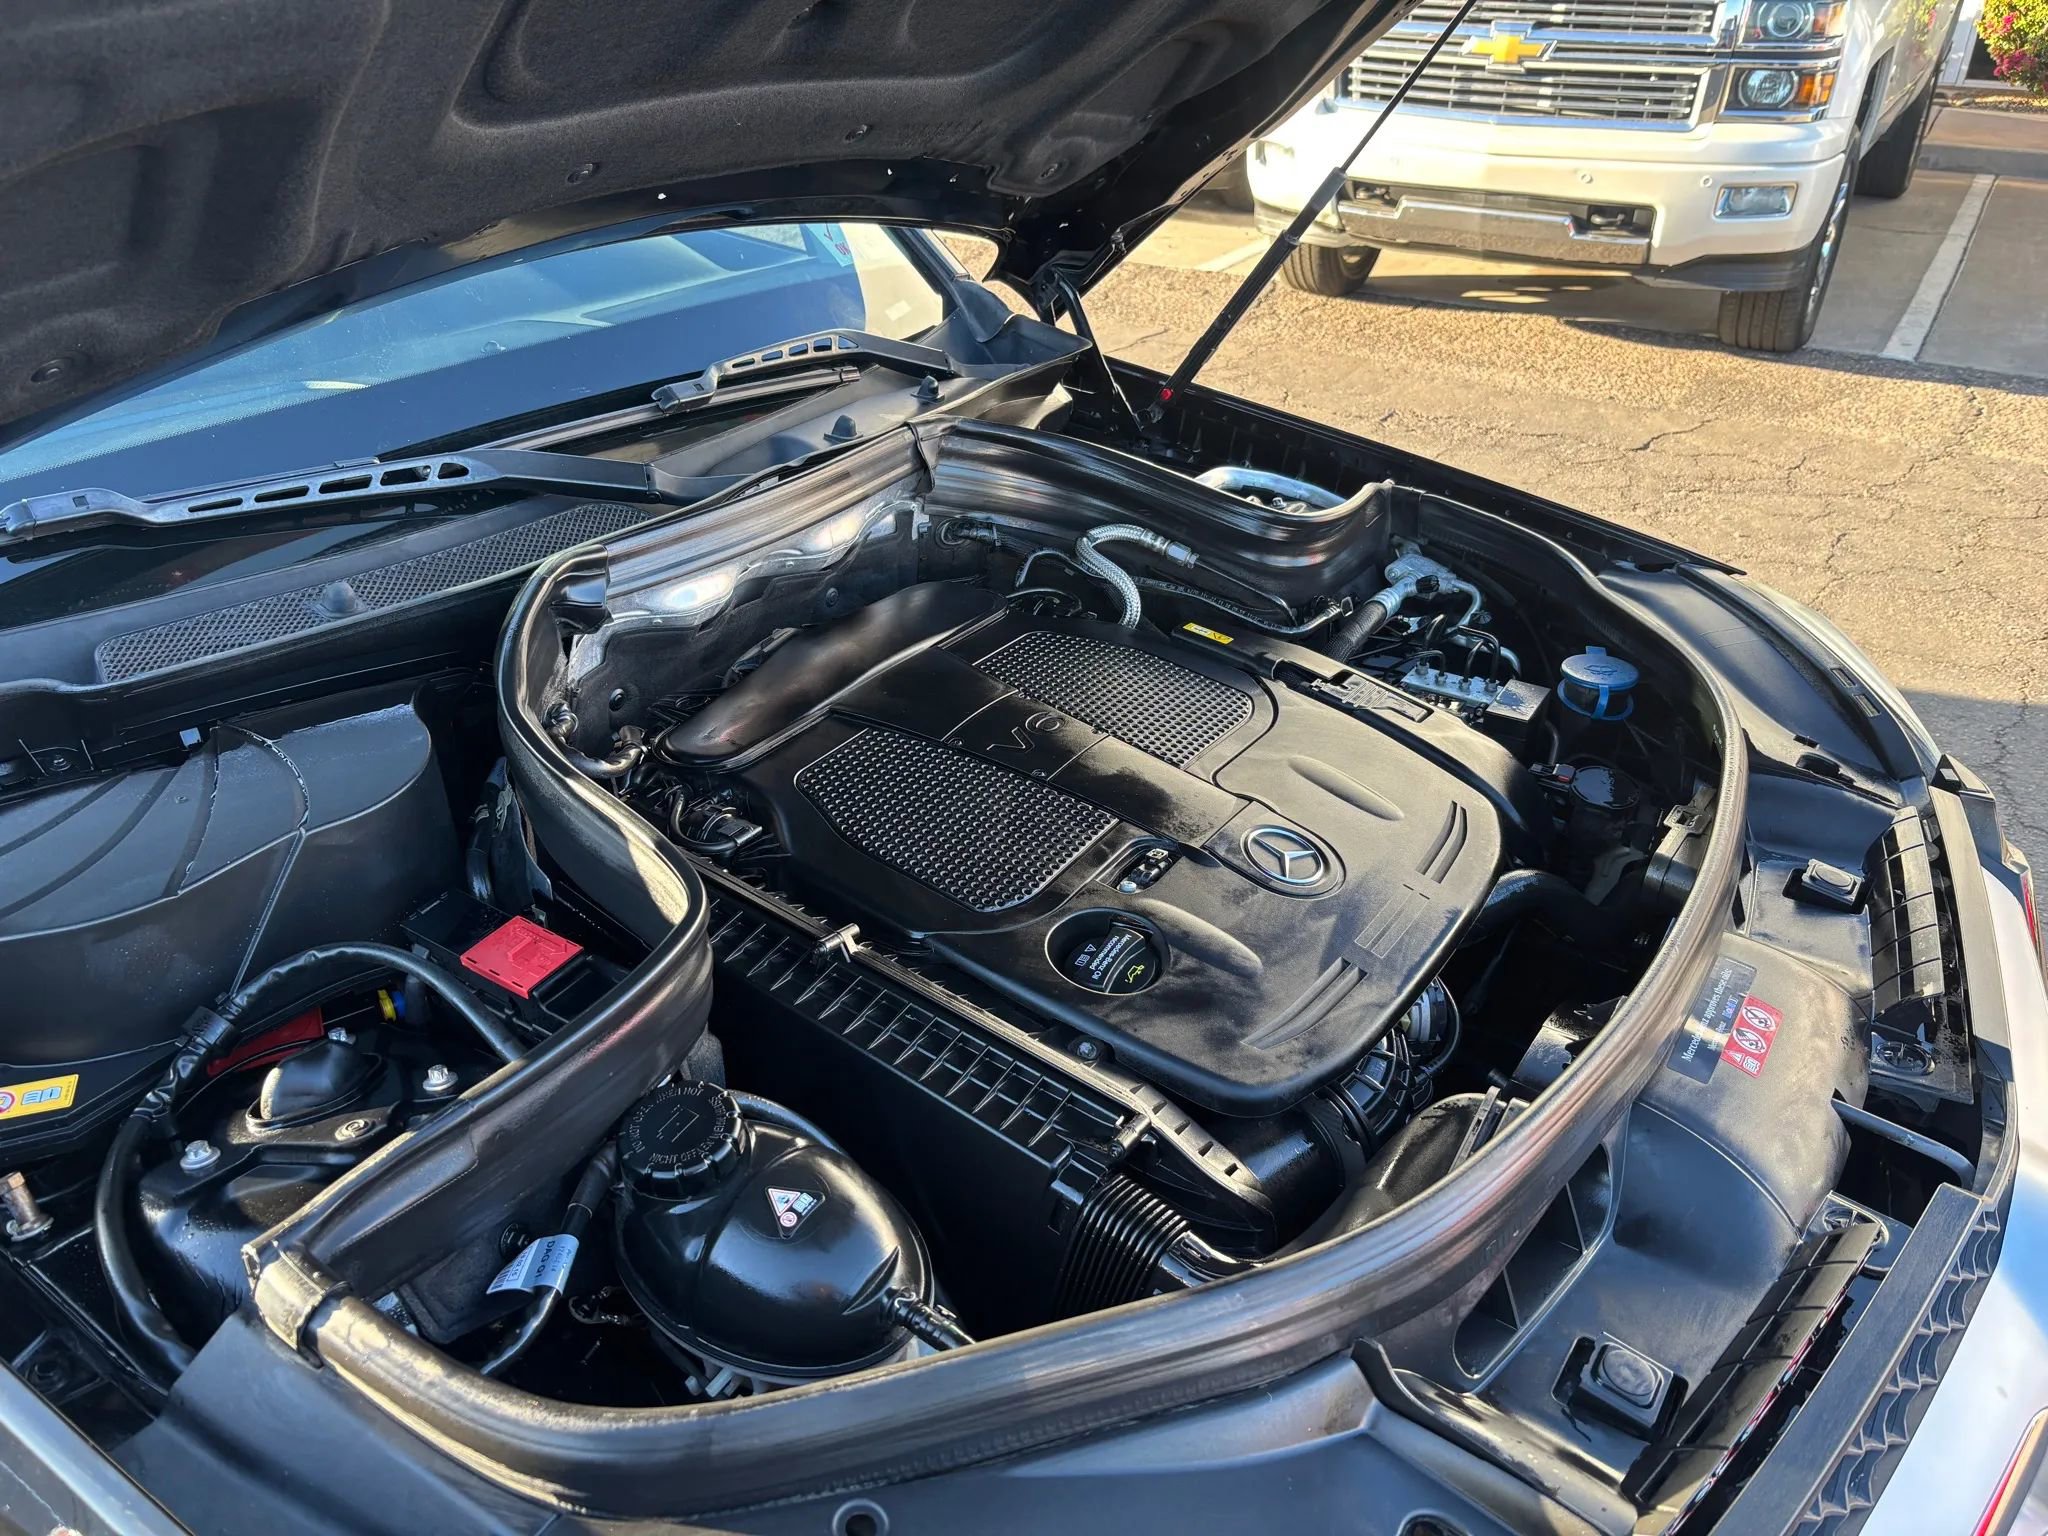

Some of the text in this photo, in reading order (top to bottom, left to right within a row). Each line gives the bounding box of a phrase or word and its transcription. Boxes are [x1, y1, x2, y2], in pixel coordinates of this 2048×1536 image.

[986, 711, 1065, 754] V6
[1090, 935, 1119, 970] recommended
[1091, 933, 1132, 980] Mercedes-Benz Oil
[1703, 994, 1721, 1019] approves
[1714, 978, 1727, 995] these
[649, 1153, 678, 1164] NICHT
